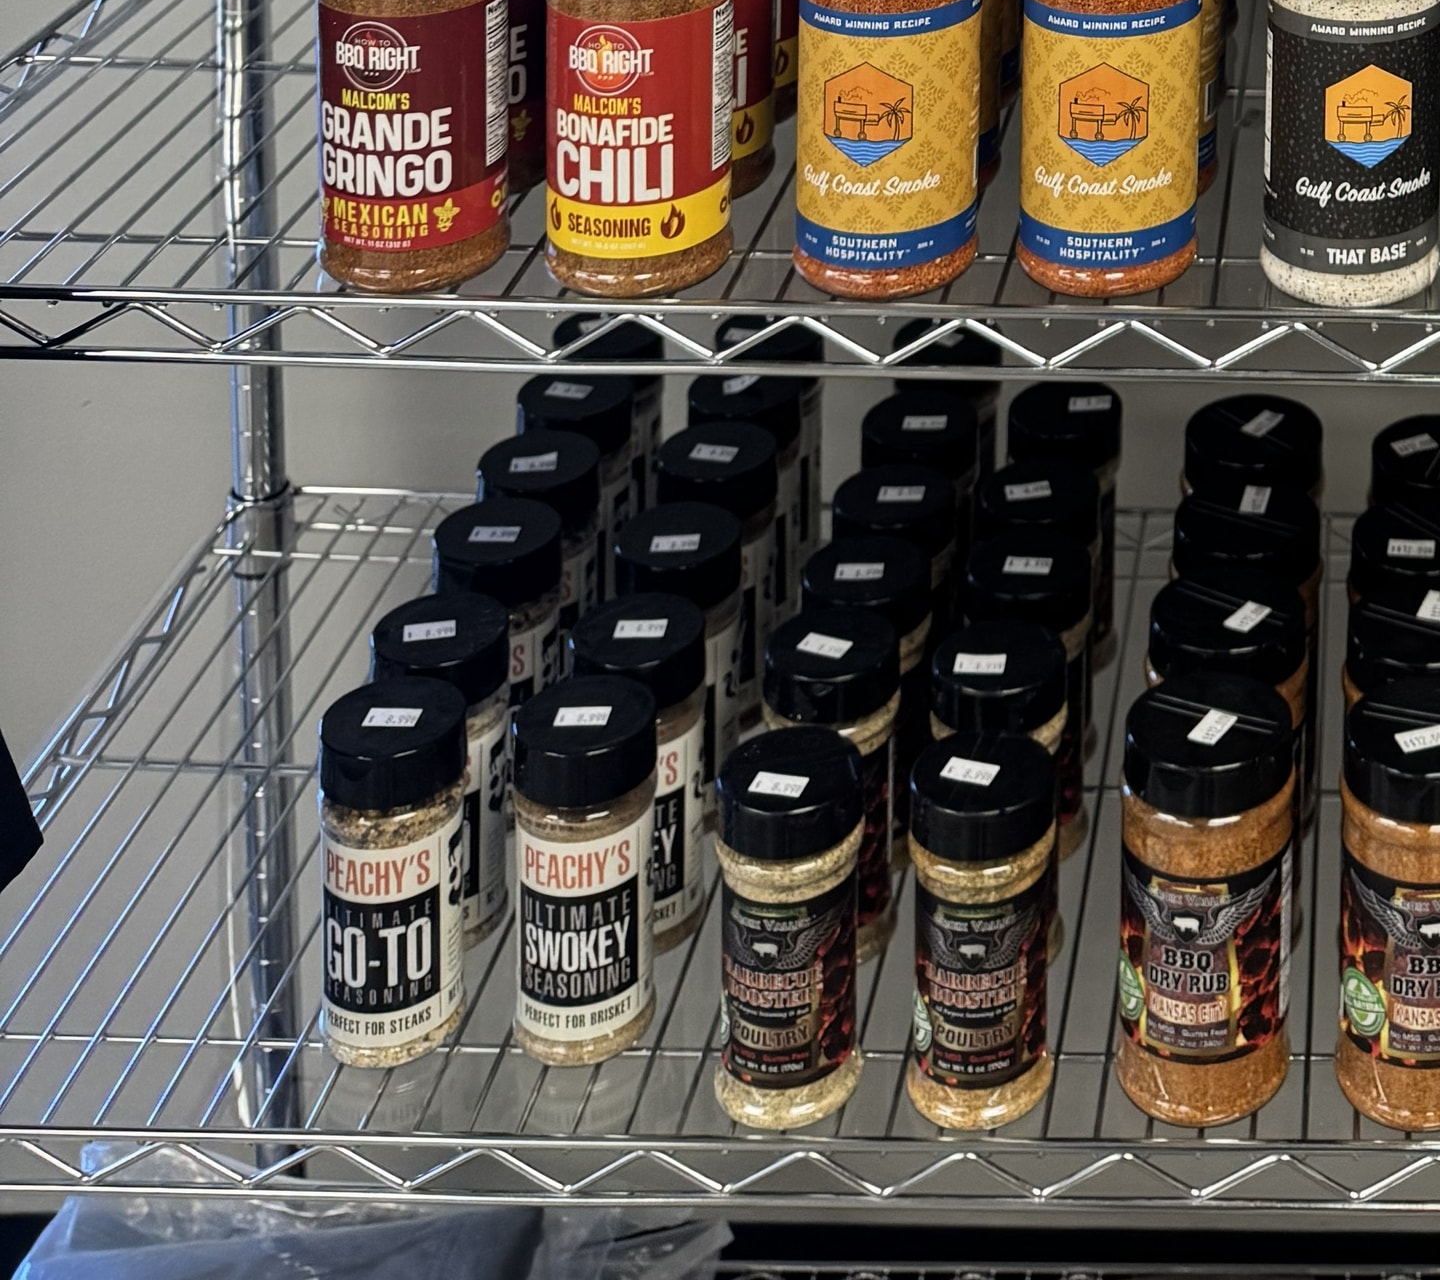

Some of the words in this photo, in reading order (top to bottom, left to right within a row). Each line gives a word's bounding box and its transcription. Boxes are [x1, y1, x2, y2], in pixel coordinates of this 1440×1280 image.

[813, 11, 843, 28] AWARD
[844, 16, 890, 30] WINNING
[894, 15, 932, 29] RECIPE
[336, 41, 363, 67] BBQ
[368, 45, 420, 71] RIGHT
[341, 88, 410, 110] MALCOM'S
[322, 100, 452, 152] GRANDE
[556, 108, 674, 148] BONAFIDE
[322, 143, 452, 198] GRINGO
[555, 144, 674, 204] CHILI
[802, 163, 830, 198] Gulf
[832, 174, 881, 197] Coast
[883, 172, 941, 195] Smoke
[1295, 174, 1333, 209] Gulf
[1335, 179, 1387, 202] Coast
[1388, 166, 1431, 198] Smoke
[333, 196, 428, 226] MEXICAN
[568, 212, 651, 239] SEASONING
[333, 218, 429, 240] SEASONING
[832, 235, 898, 248] SOUTHERN
[1326, 245, 1369, 266] THAT
[1369, 243, 1407, 264] BASE
[326, 849, 431, 897] PEACHY'S
[525, 840, 630, 889] PEACHY'S
[524, 889, 631, 931] ULTIMATE
[326, 917, 432, 988] GO-TO
[1163, 948, 1214, 972] BBQ
[525, 956, 631, 999] SEASONING
[1149, 968, 1184, 992] DRY
[1189, 972, 1229, 994] RUB
[364, 1020, 386, 1036] FOR
[389, 1006, 433, 1033] STEAKS
[524, 1003, 560, 1028] PERFECT
[565, 1015, 585, 1029] FOR
[590, 996, 632, 1026] BRISKET
[732, 1019, 808, 1048] POULTRY
